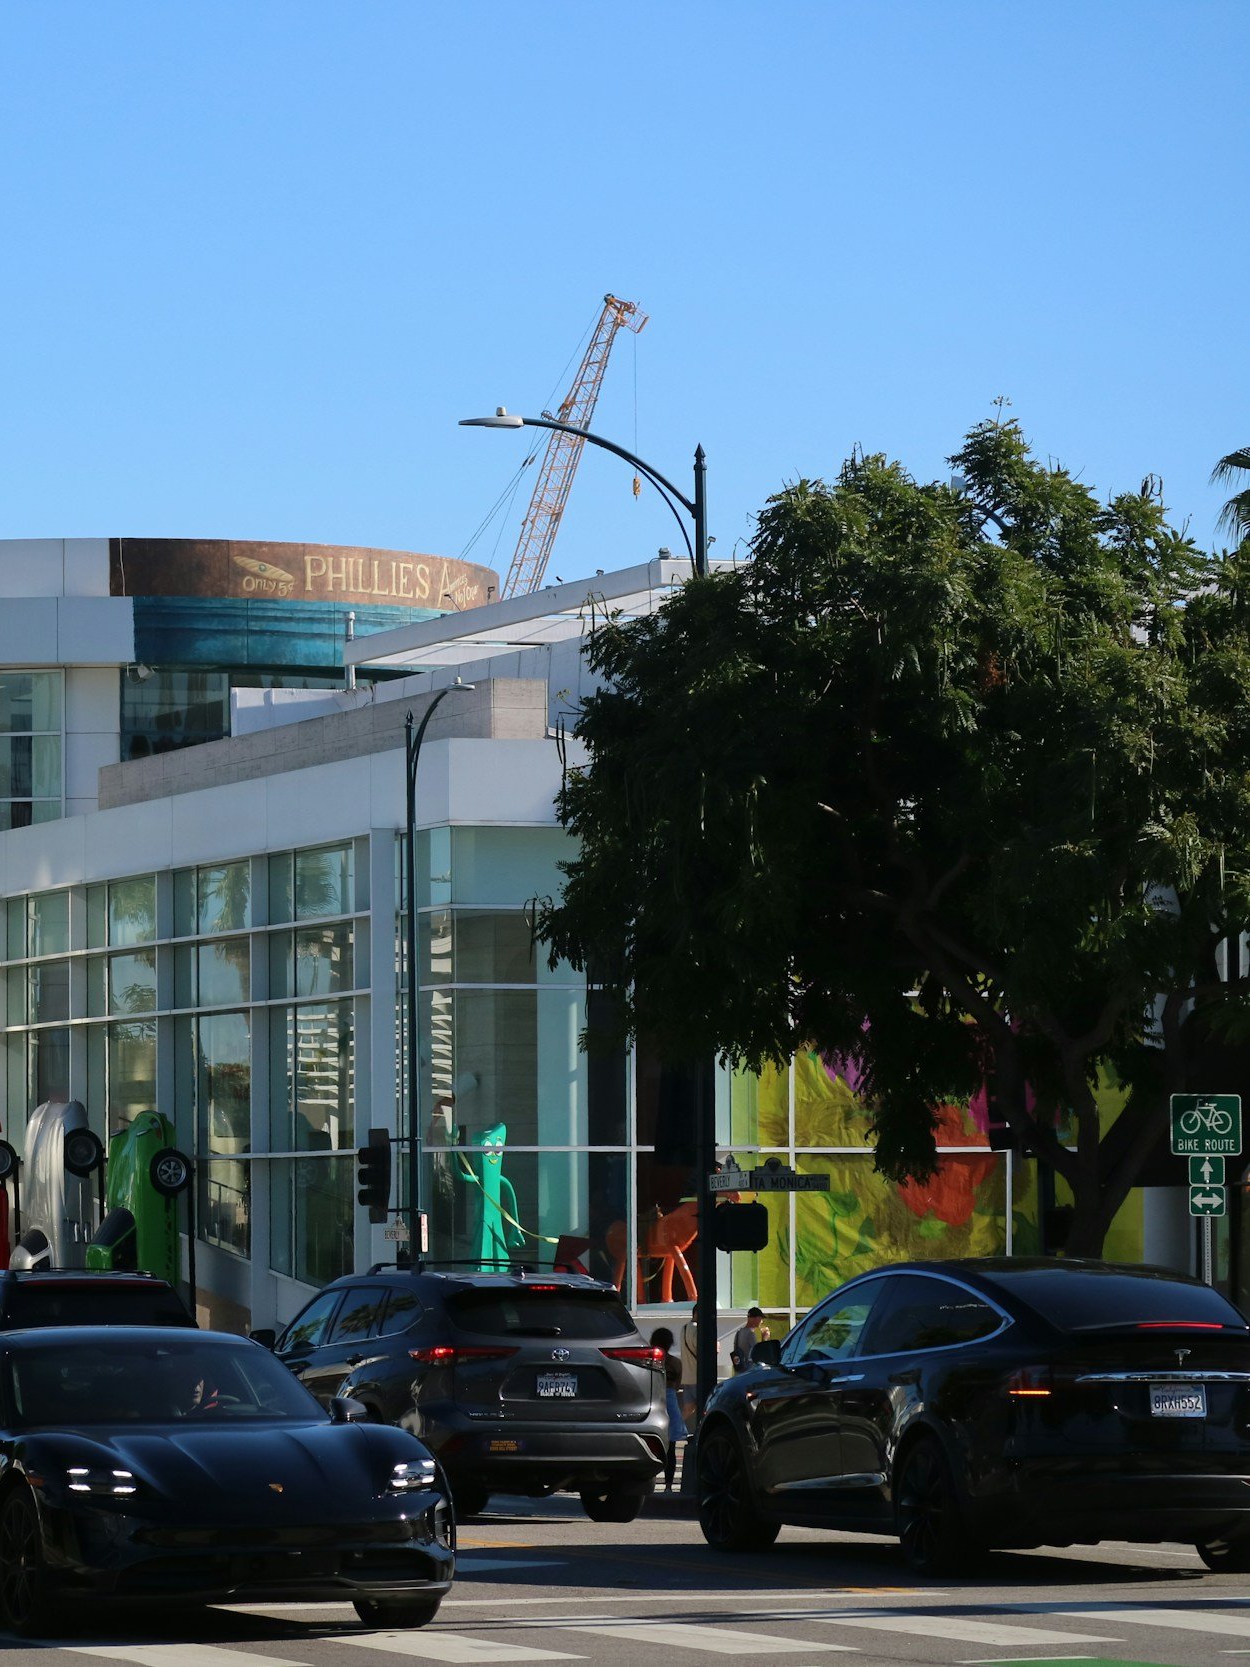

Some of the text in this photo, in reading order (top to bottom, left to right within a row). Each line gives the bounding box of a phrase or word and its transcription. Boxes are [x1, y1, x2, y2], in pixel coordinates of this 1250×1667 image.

[243, 575, 276, 593] Only
[304, 556, 430, 600] PHILLIES
[1178, 1139, 1235, 1151] BIKE ROUTE
[711, 1176, 730, 1189] BEVERLY
[770, 1176, 810, 1189] MONICA
[1154, 1395, 1203, 1410] 8RXH552
